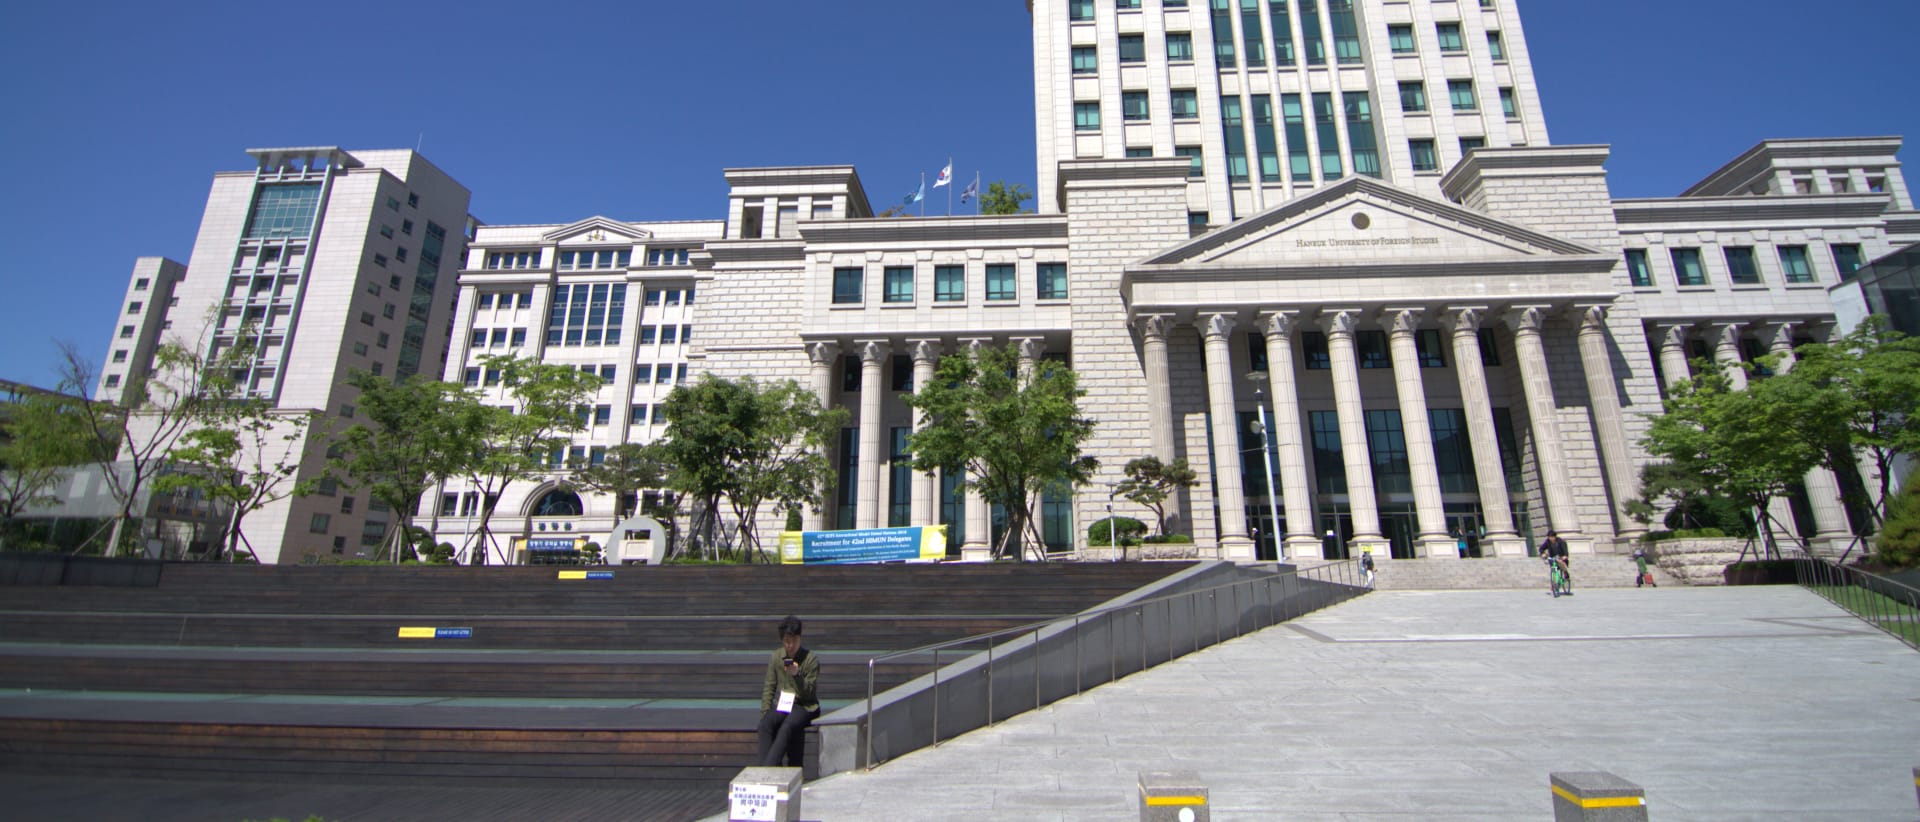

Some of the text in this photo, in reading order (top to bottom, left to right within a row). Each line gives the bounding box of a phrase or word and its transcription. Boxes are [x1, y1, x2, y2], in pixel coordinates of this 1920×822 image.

[1296, 239, 1326, 248] HANKUK
[1328, 238, 1370, 247] UNIVERSITY
[1380, 237, 1410, 246] FOREIGN
[1411, 236, 1439, 245] STUDIES
